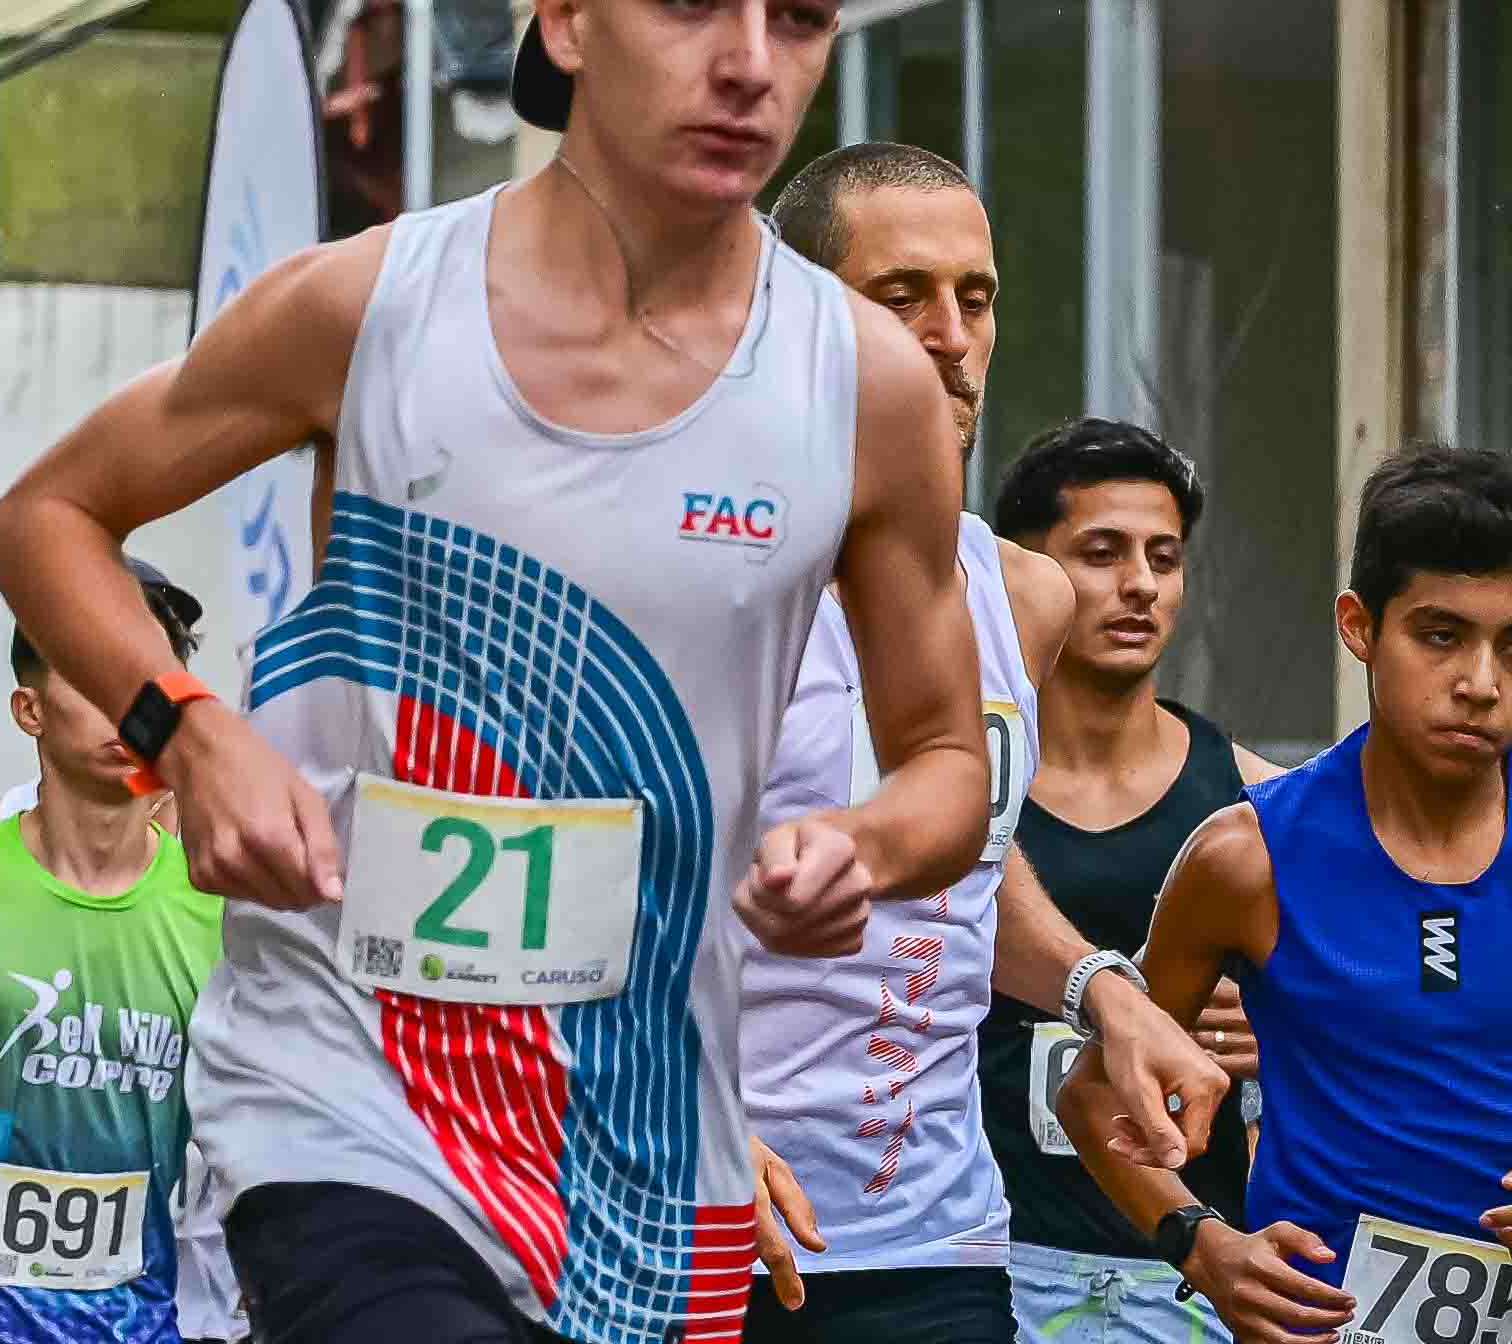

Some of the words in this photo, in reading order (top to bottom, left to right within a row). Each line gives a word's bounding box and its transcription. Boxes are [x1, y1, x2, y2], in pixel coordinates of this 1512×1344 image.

[680, 492, 776, 541] FAC
[412, 814, 556, 951] 21
[2, 1180, 129, 1260] 691
